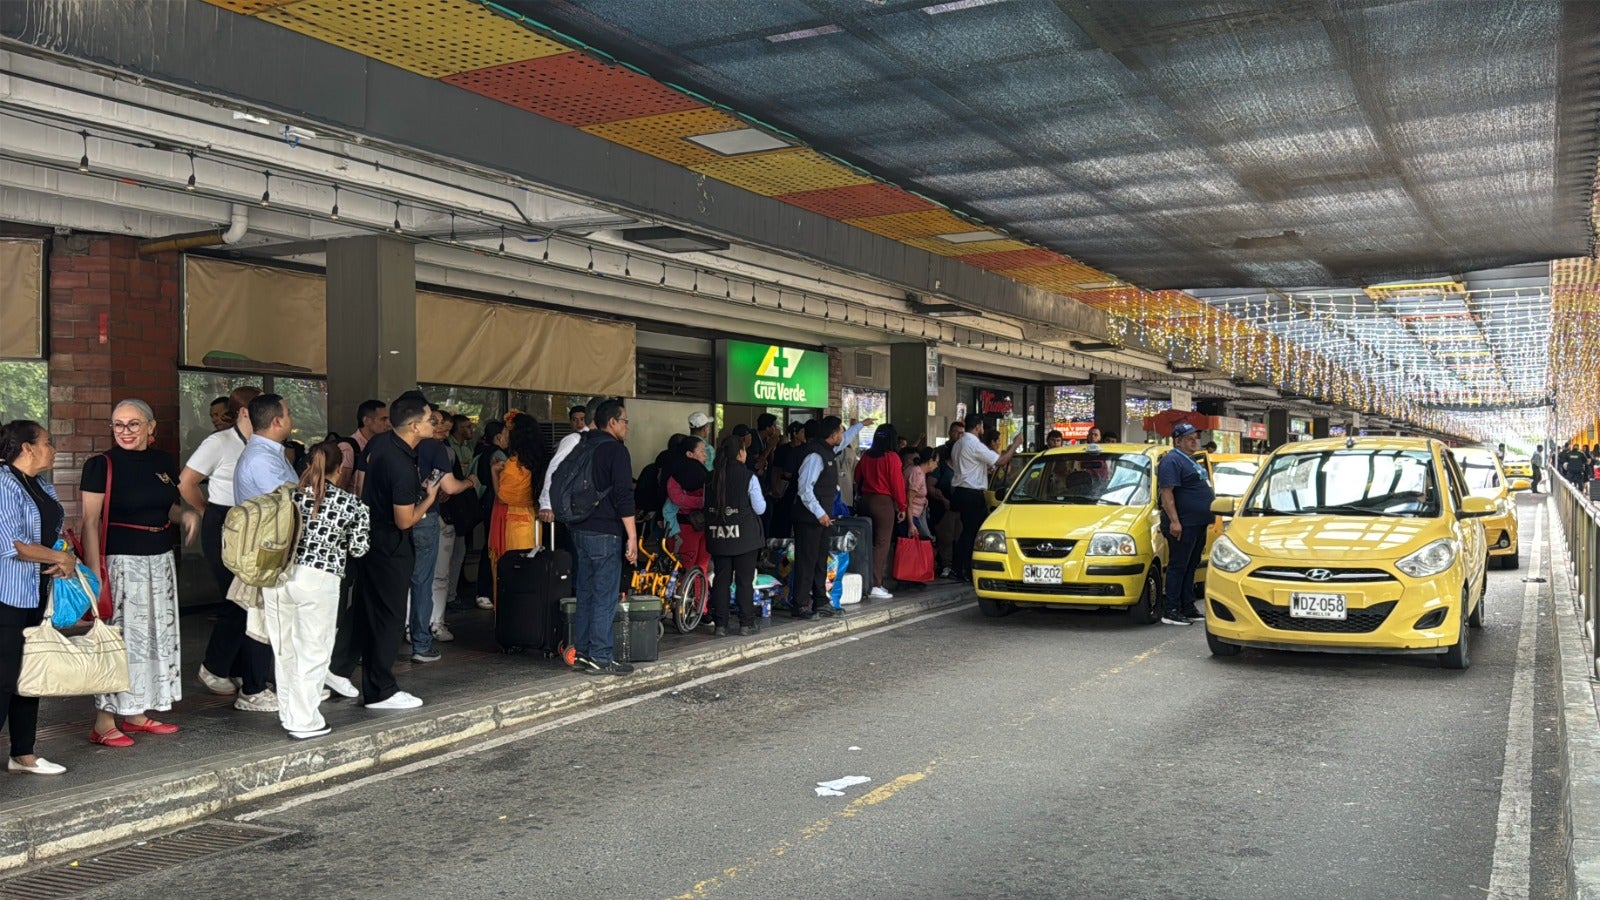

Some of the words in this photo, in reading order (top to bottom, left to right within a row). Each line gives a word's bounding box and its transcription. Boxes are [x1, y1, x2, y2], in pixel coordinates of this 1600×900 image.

[754, 379, 776, 400] Cruz
[776, 382, 805, 402] Verde
[709, 525, 740, 539] TAXI
